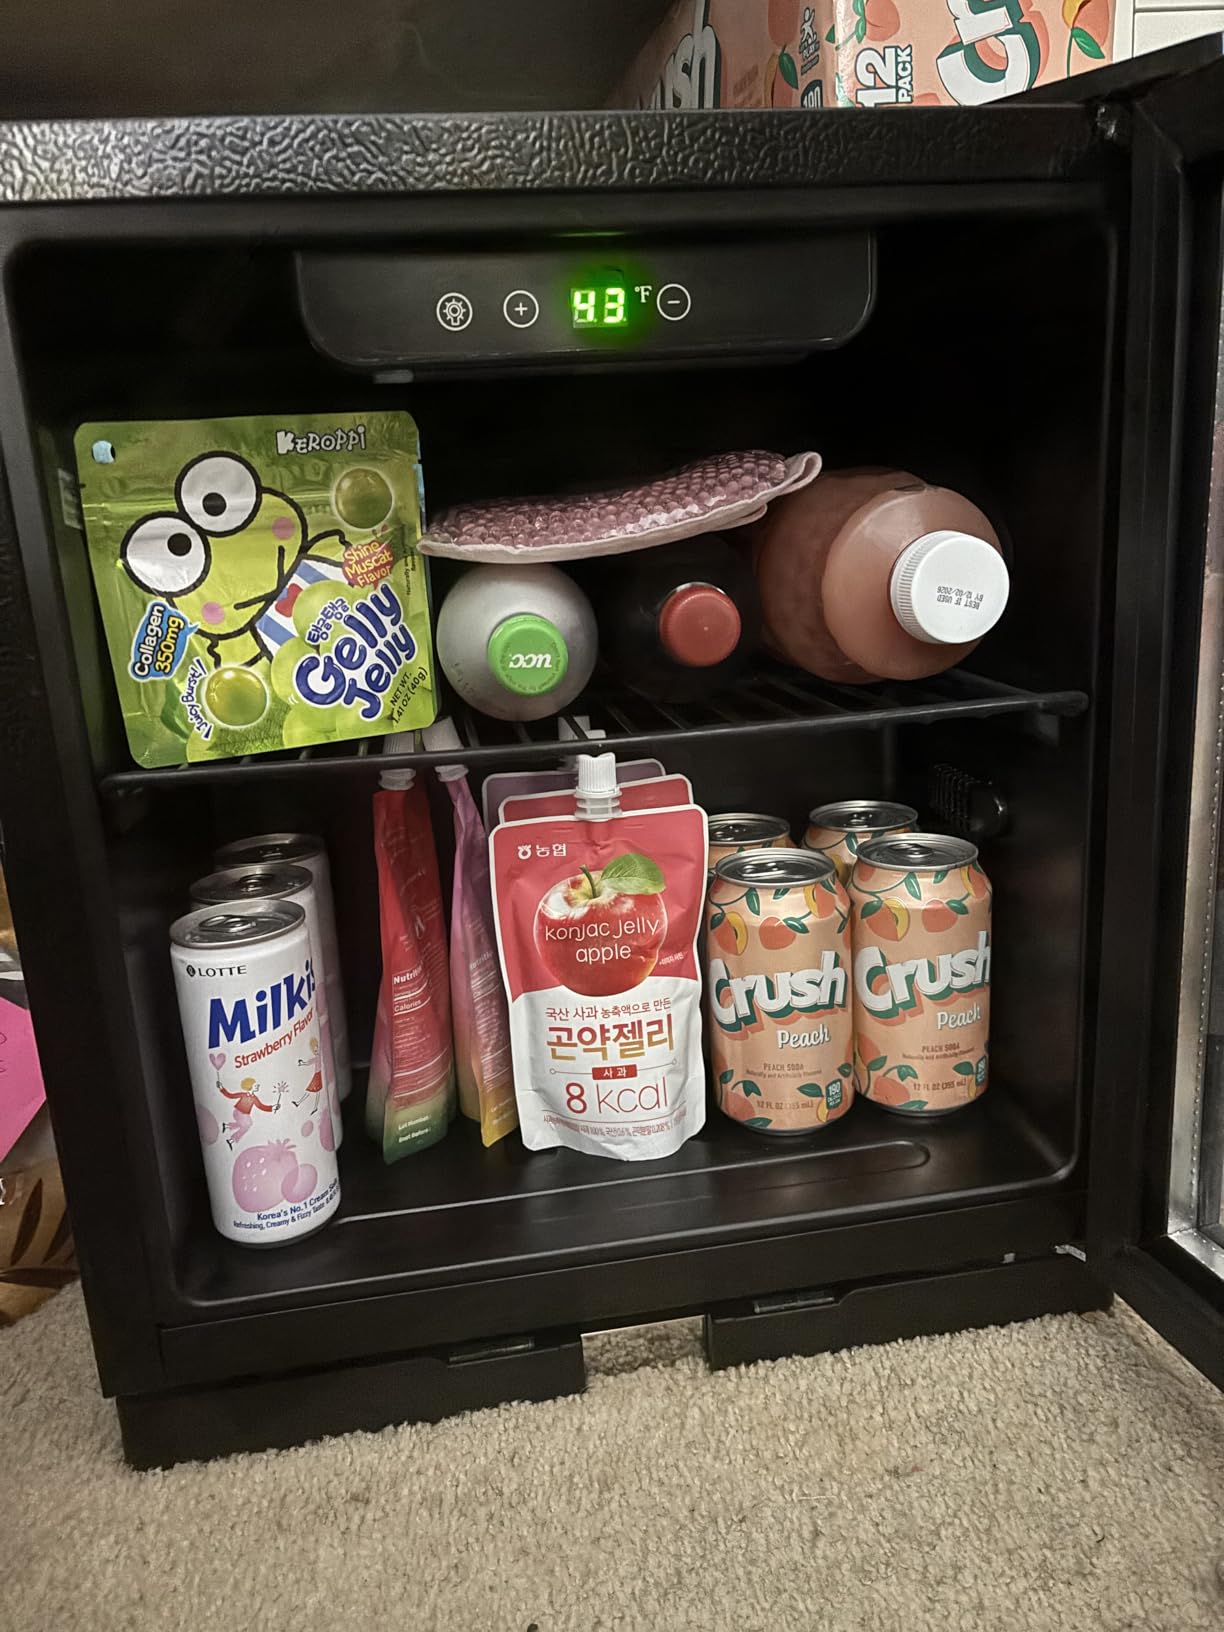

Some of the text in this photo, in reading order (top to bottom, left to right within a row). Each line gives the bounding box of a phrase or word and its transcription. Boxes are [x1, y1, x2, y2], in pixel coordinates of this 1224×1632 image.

[855, 47, 897, 107] 12
[897, 44, 913, 103] PACK
[573, 287, 626, 324] 43
[634, 285, 652, 304] °F
[344, 541, 380, 565] Shine
[344, 549, 394, 579] Muscat
[356, 565, 391, 587] Flavor
[937, 594, 953, 604] USED
[974, 593, 984, 602] BY
[306, 597, 350, 644] 탱글탱글
[134, 605, 165, 676] Collagen
[155, 616, 185, 674] 350mg
[295, 583, 402, 706] Gelly
[343, 623, 416, 720] Jelly
[407, 666, 429, 696] (40g)
[390, 671, 412, 707] NET WT.
[188, 704, 208, 731] Juicy
[536, 843, 567, 858] 농협
[545, 917, 660, 942] konjac jelly
[575, 943, 632, 965] apple
[198, 965, 248, 978] LOTTE
[854, 930, 991, 1018] Crush
[709, 950, 848, 1032] Crush
[545, 997, 672, 1022] 국산 사과 농축액으로 만든
[936, 1002, 982, 1030] Peach
[234, 1007, 315, 1069] Strawberry Flavor
[546, 1013, 675, 1062] 곤약젤리
[776, 1023, 831, 1049] Peach
[921, 1044, 943, 1053] PEACH
[603, 1066, 628, 1079] 사과
[763, 1062, 804, 1072] PEACH SODA
[596, 1076, 668, 1115] kcal
[257, 1209, 288, 1221] Korea's
[290, 1205, 303, 1215] No.
[309, 1190, 329, 1207] Cream
[266, 1218, 290, 1229] Creamy
[297, 1210, 312, 1221] Fizzy
